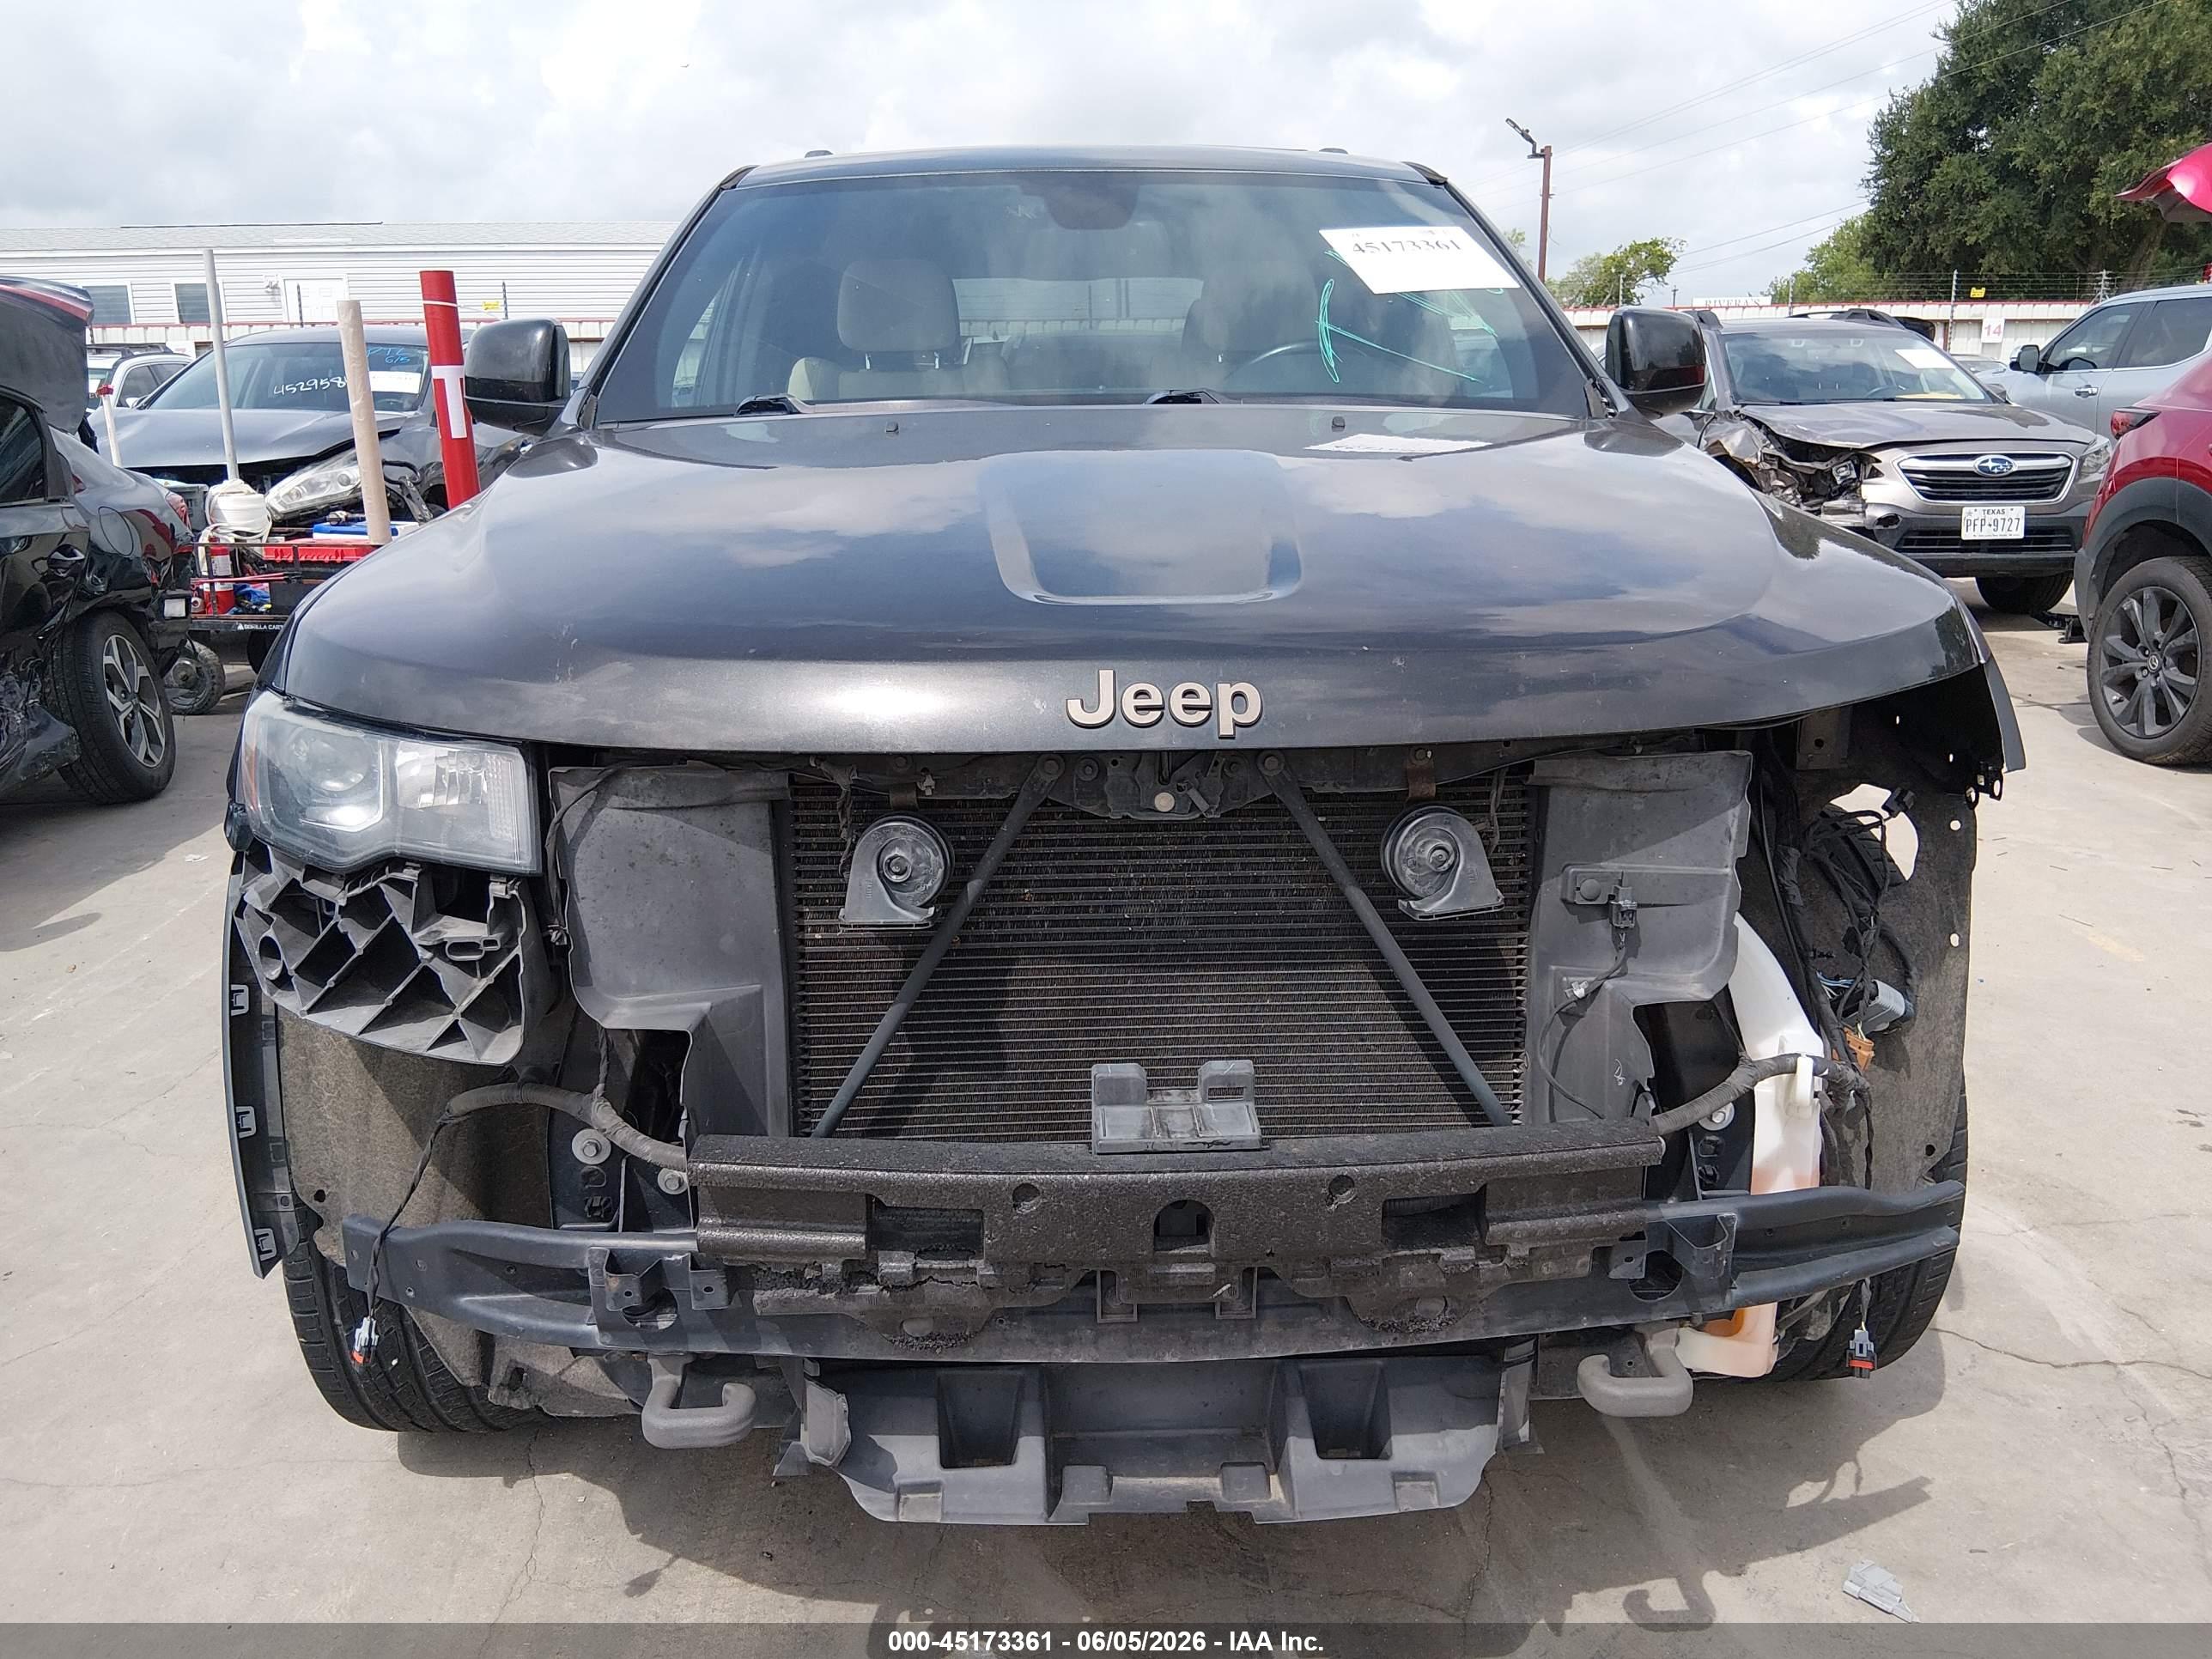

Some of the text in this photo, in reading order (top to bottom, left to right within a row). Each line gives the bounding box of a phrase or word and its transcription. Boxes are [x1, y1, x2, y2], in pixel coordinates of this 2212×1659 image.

[1352, 240, 1462, 254] 45173361
[1984, 324, 2002, 337] 14
[273, 374, 347, 396] 452958
[1066, 669, 1263, 739] Jeep
